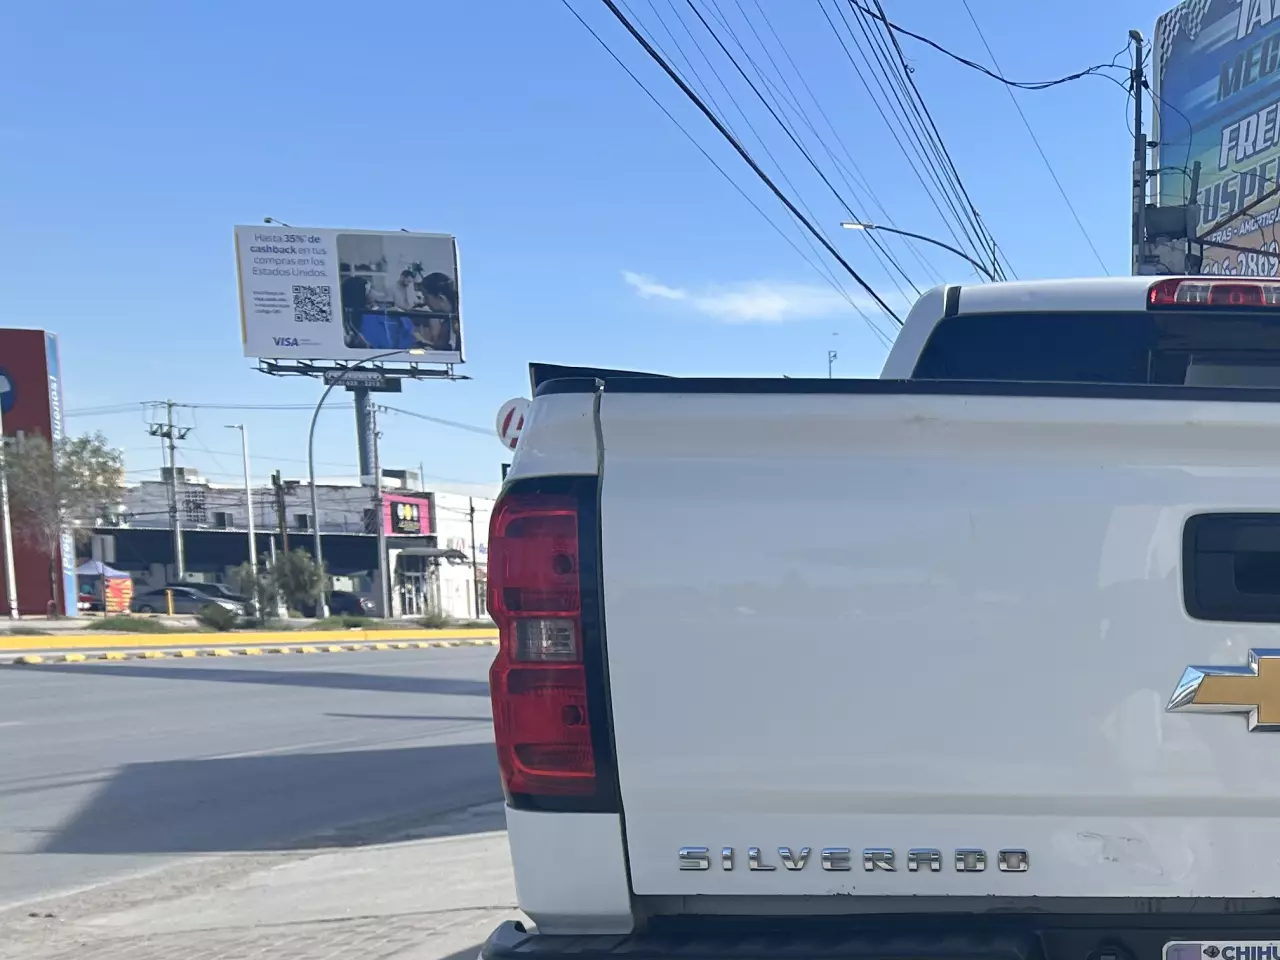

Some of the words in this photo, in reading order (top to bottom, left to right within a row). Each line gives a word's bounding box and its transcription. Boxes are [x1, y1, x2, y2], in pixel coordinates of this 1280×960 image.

[254, 233, 281, 243] Hasta
[308, 235, 321, 243] de
[250, 245, 297, 254] cashback
[312, 247, 326, 255] tus
[254, 257, 296, 265] compras
[311, 257, 325, 266] los
[252, 267, 290, 276] Estados
[272, 337, 299, 346] VISA
[679, 846, 1030, 872] SILVERADO
